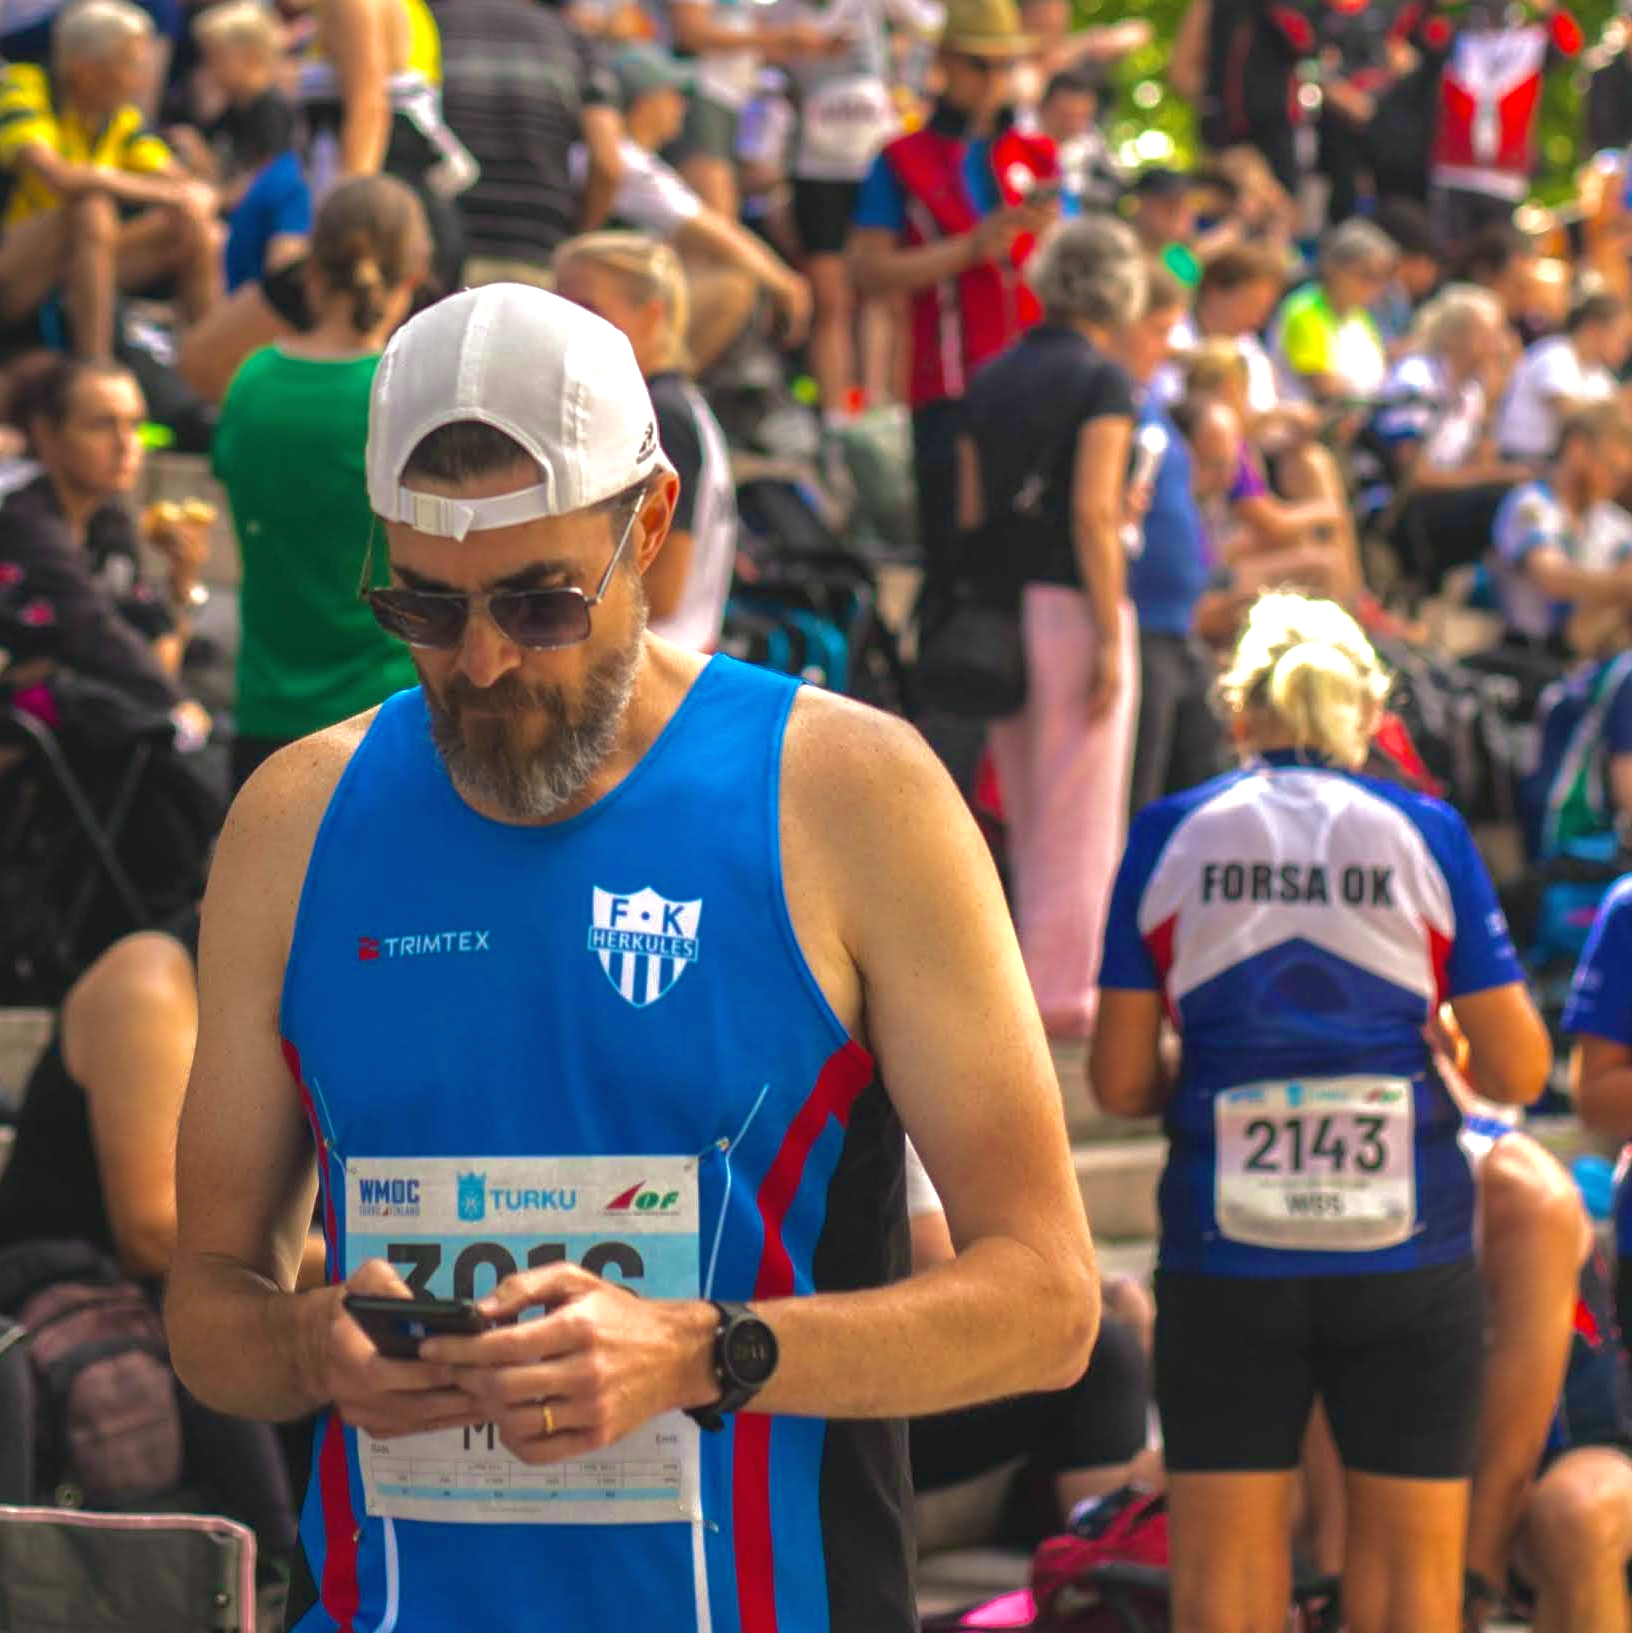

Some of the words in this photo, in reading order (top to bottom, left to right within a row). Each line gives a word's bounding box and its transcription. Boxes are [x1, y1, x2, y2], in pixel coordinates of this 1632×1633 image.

[1202, 863, 1329, 904] FORSA
[1343, 864, 1393, 906] OK
[383, 930, 491, 958] TRIMTEX
[592, 930, 695, 958] HERKULES
[1243, 1115, 1387, 1173] 2143
[359, 1179, 420, 1204] WMOC
[489, 1188, 577, 1211] TURKU
